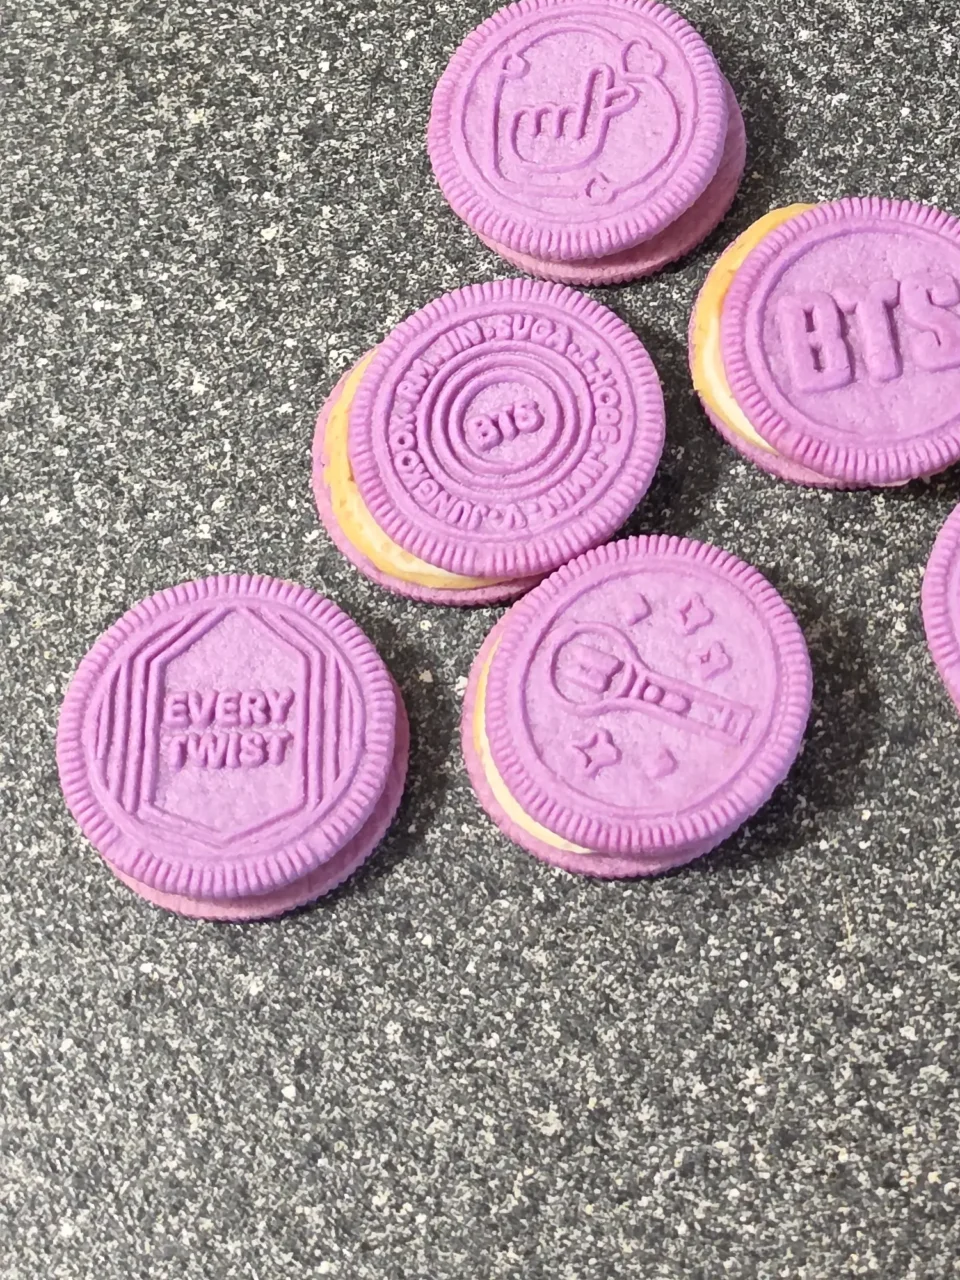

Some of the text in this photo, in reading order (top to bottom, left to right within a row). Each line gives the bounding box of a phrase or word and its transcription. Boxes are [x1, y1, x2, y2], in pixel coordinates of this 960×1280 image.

[463, 398, 546, 453] BTS
[161, 686, 296, 727] EVERY
[161, 730, 295, 770] TWIST
